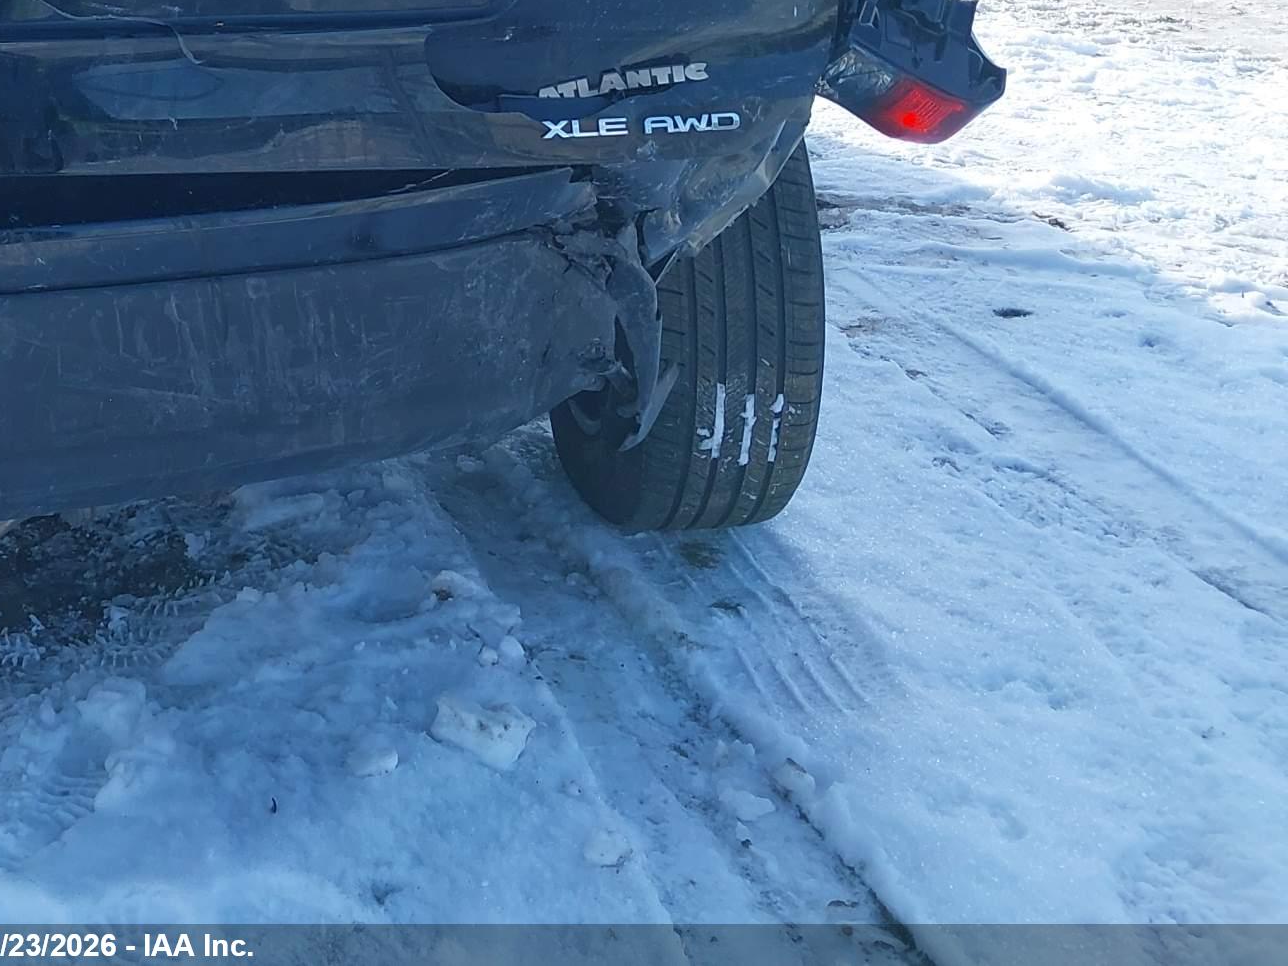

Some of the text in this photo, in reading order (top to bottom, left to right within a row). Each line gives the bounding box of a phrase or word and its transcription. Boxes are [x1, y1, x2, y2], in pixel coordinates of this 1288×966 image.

[538, 62, 710, 99] ATLANTIC
[542, 112, 741, 139] XLE AWD
